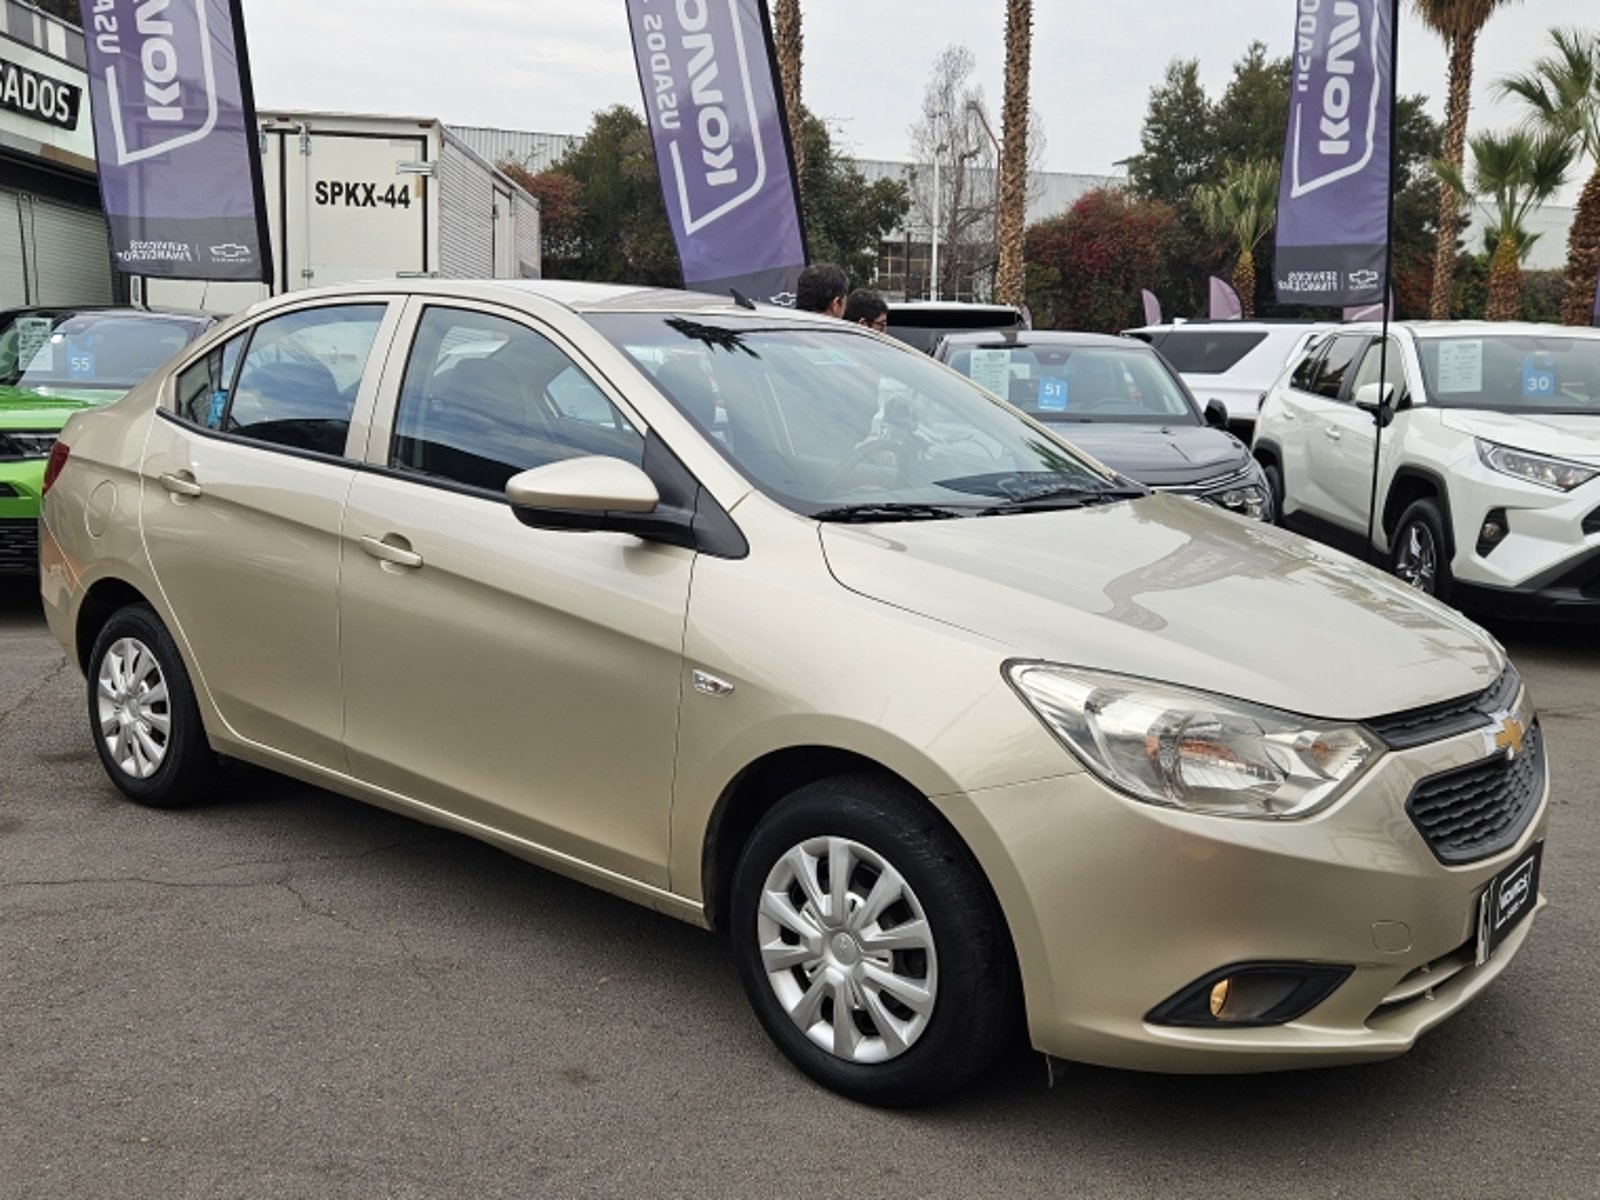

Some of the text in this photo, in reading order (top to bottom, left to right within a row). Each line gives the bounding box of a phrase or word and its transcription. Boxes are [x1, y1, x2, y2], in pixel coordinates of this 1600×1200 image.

[0, 65, 70, 122] ADOS
[315, 180, 411, 209] SPKX-44
[71, 357, 91, 371] 55
[1045, 383, 1061, 396] 51
[1527, 376, 1549, 391] 30
